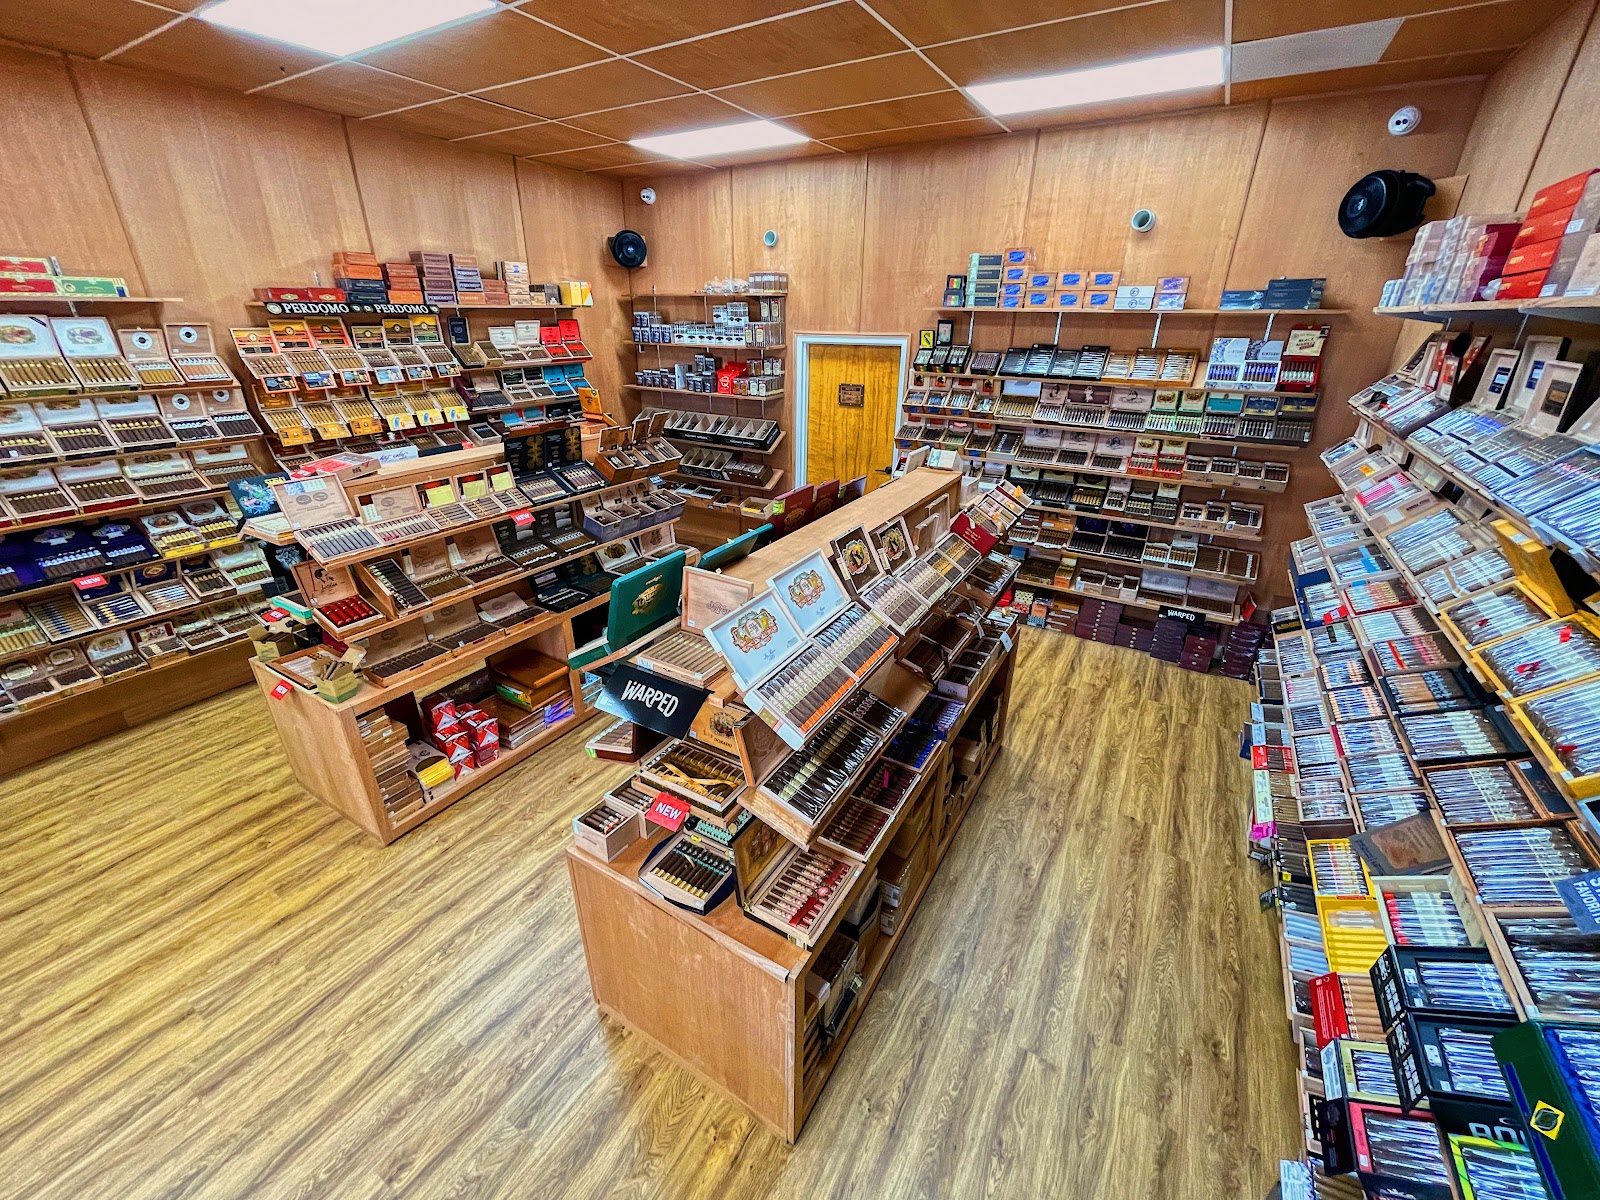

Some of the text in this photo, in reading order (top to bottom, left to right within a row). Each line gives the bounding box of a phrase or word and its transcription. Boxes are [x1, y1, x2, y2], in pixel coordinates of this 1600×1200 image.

[282, 303, 349, 314] PERDOMO
[375, 304, 429, 314] PERDOMO
[515, 511, 531, 522] NEW
[79, 576, 102, 586] NEW
[1168, 609, 1195, 621] WARPED
[621, 680, 679, 718] WARPED
[655, 801, 682, 821] NEW
